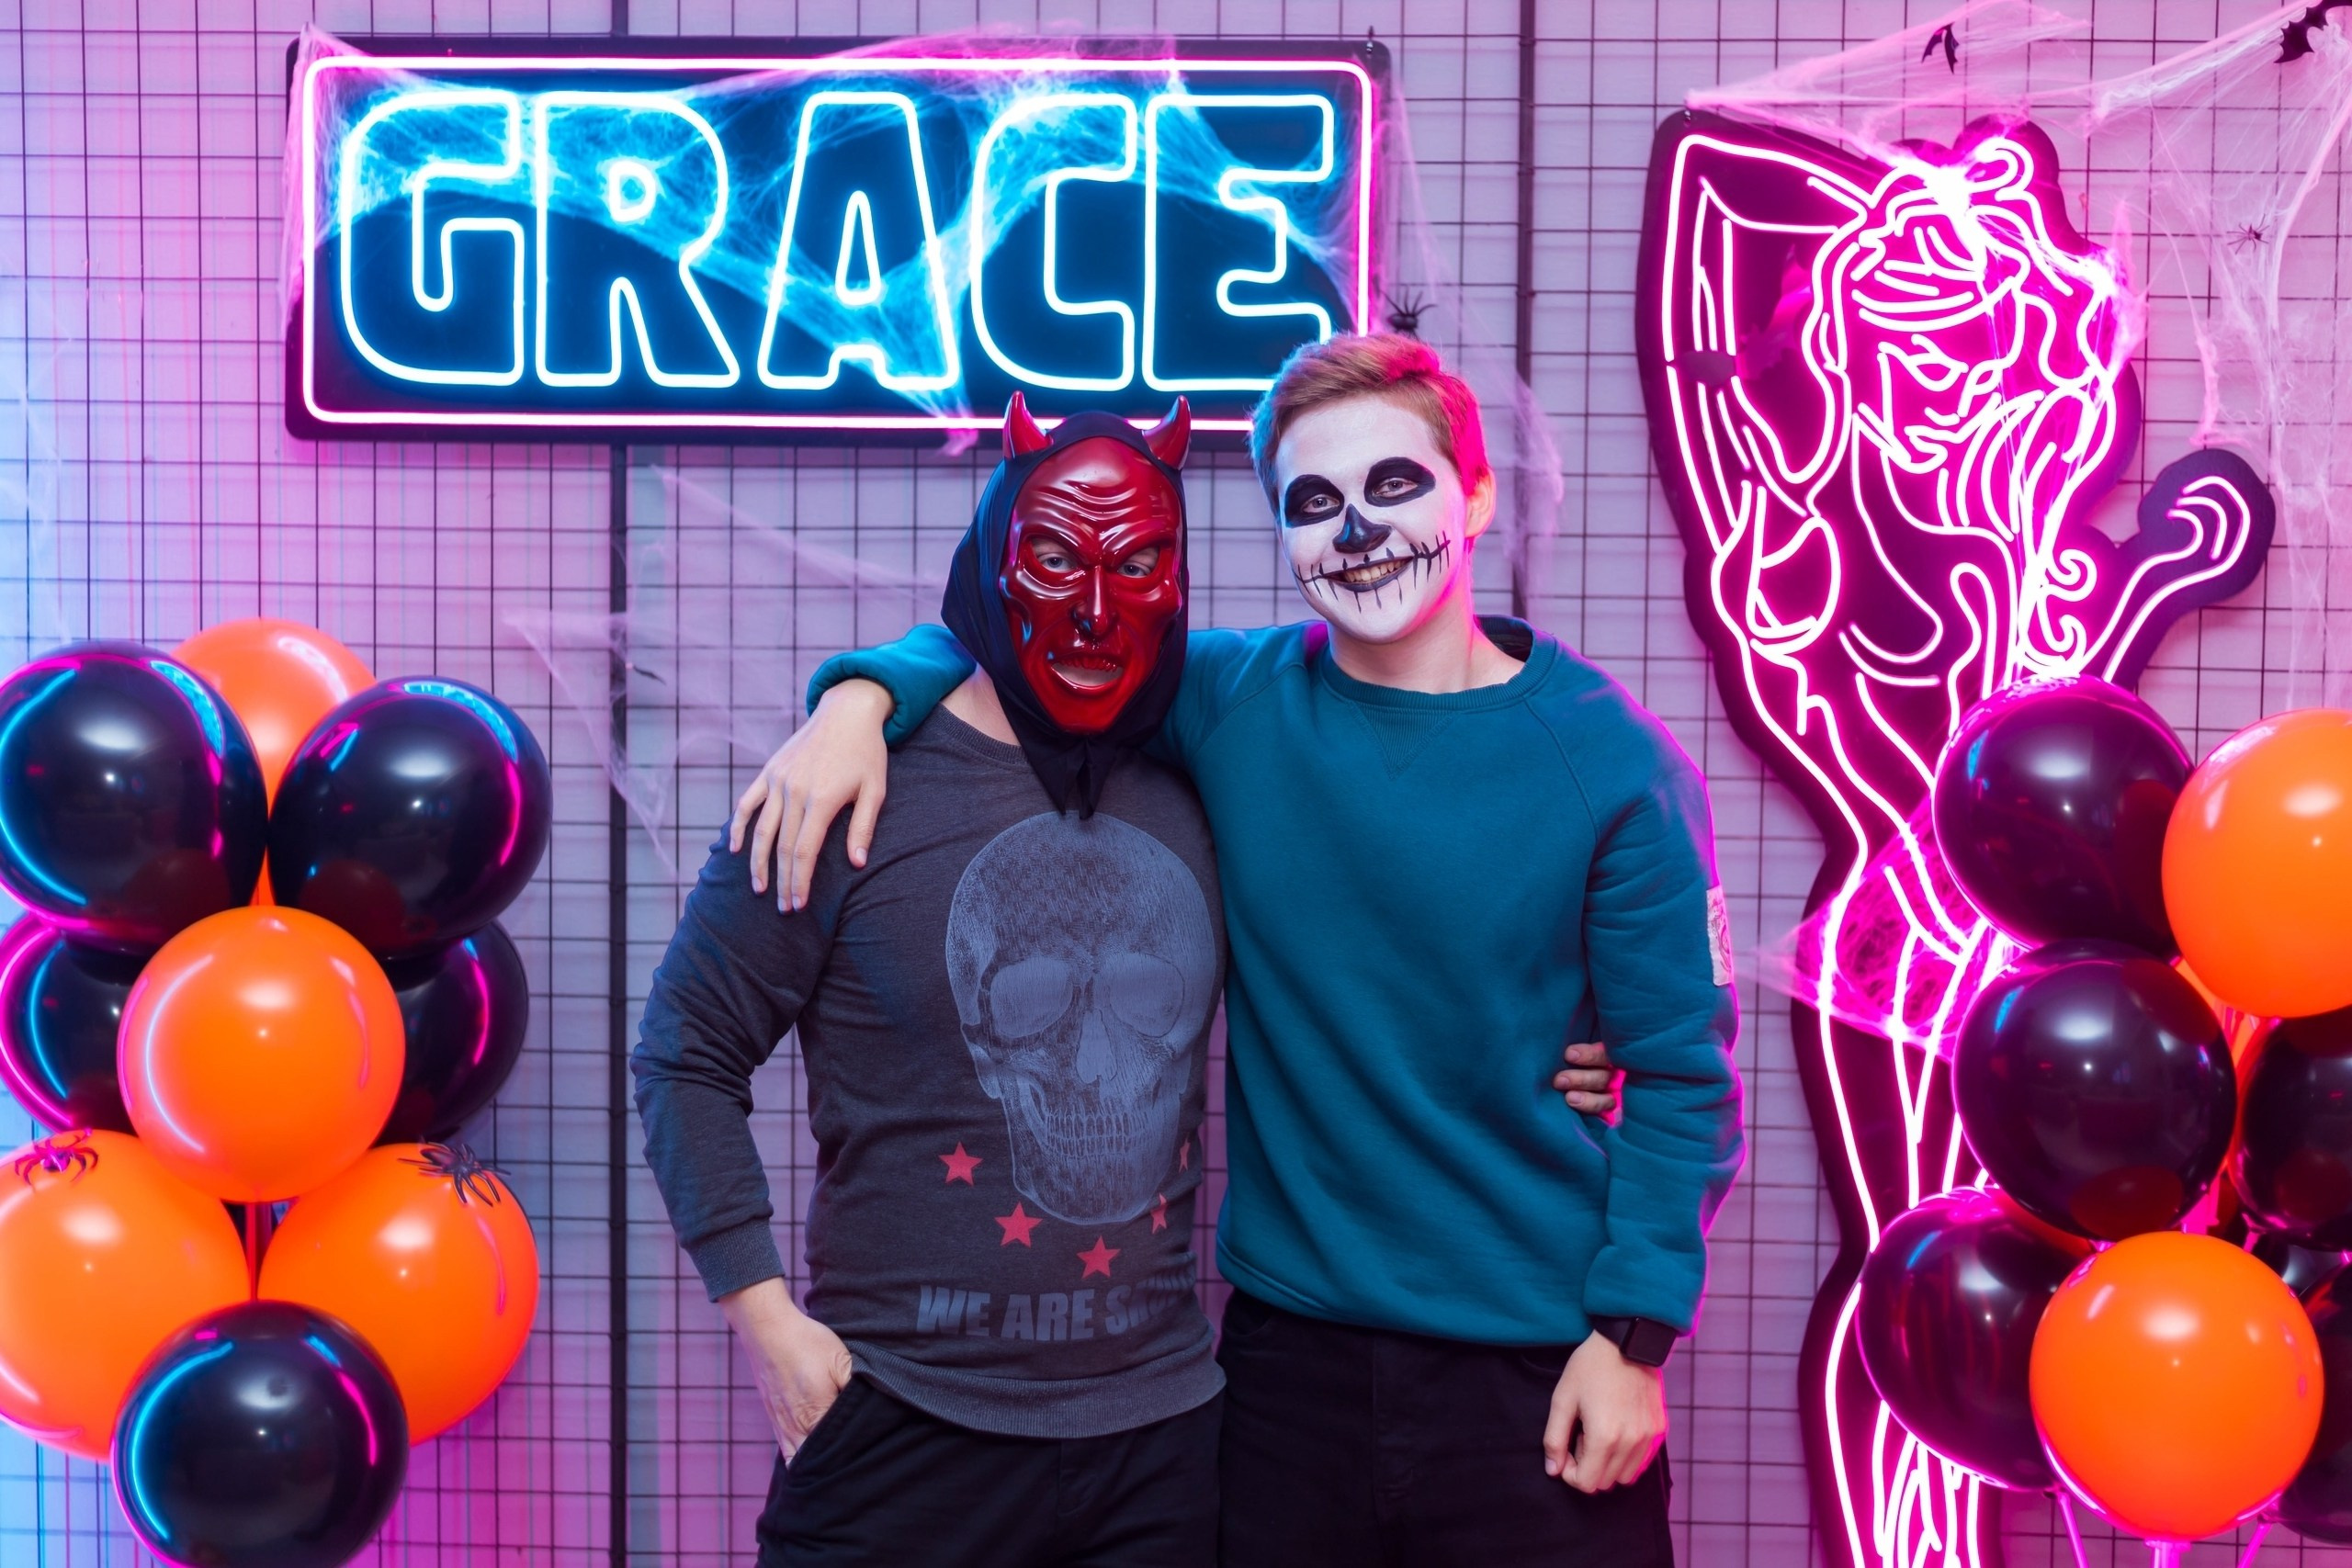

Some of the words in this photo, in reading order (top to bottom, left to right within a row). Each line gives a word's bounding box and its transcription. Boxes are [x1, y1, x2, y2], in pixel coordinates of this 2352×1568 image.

[340, 90, 1334, 391] GRACE
[917, 1286, 990, 1337] WE
[1001, 1290, 1095, 1340] ARE
